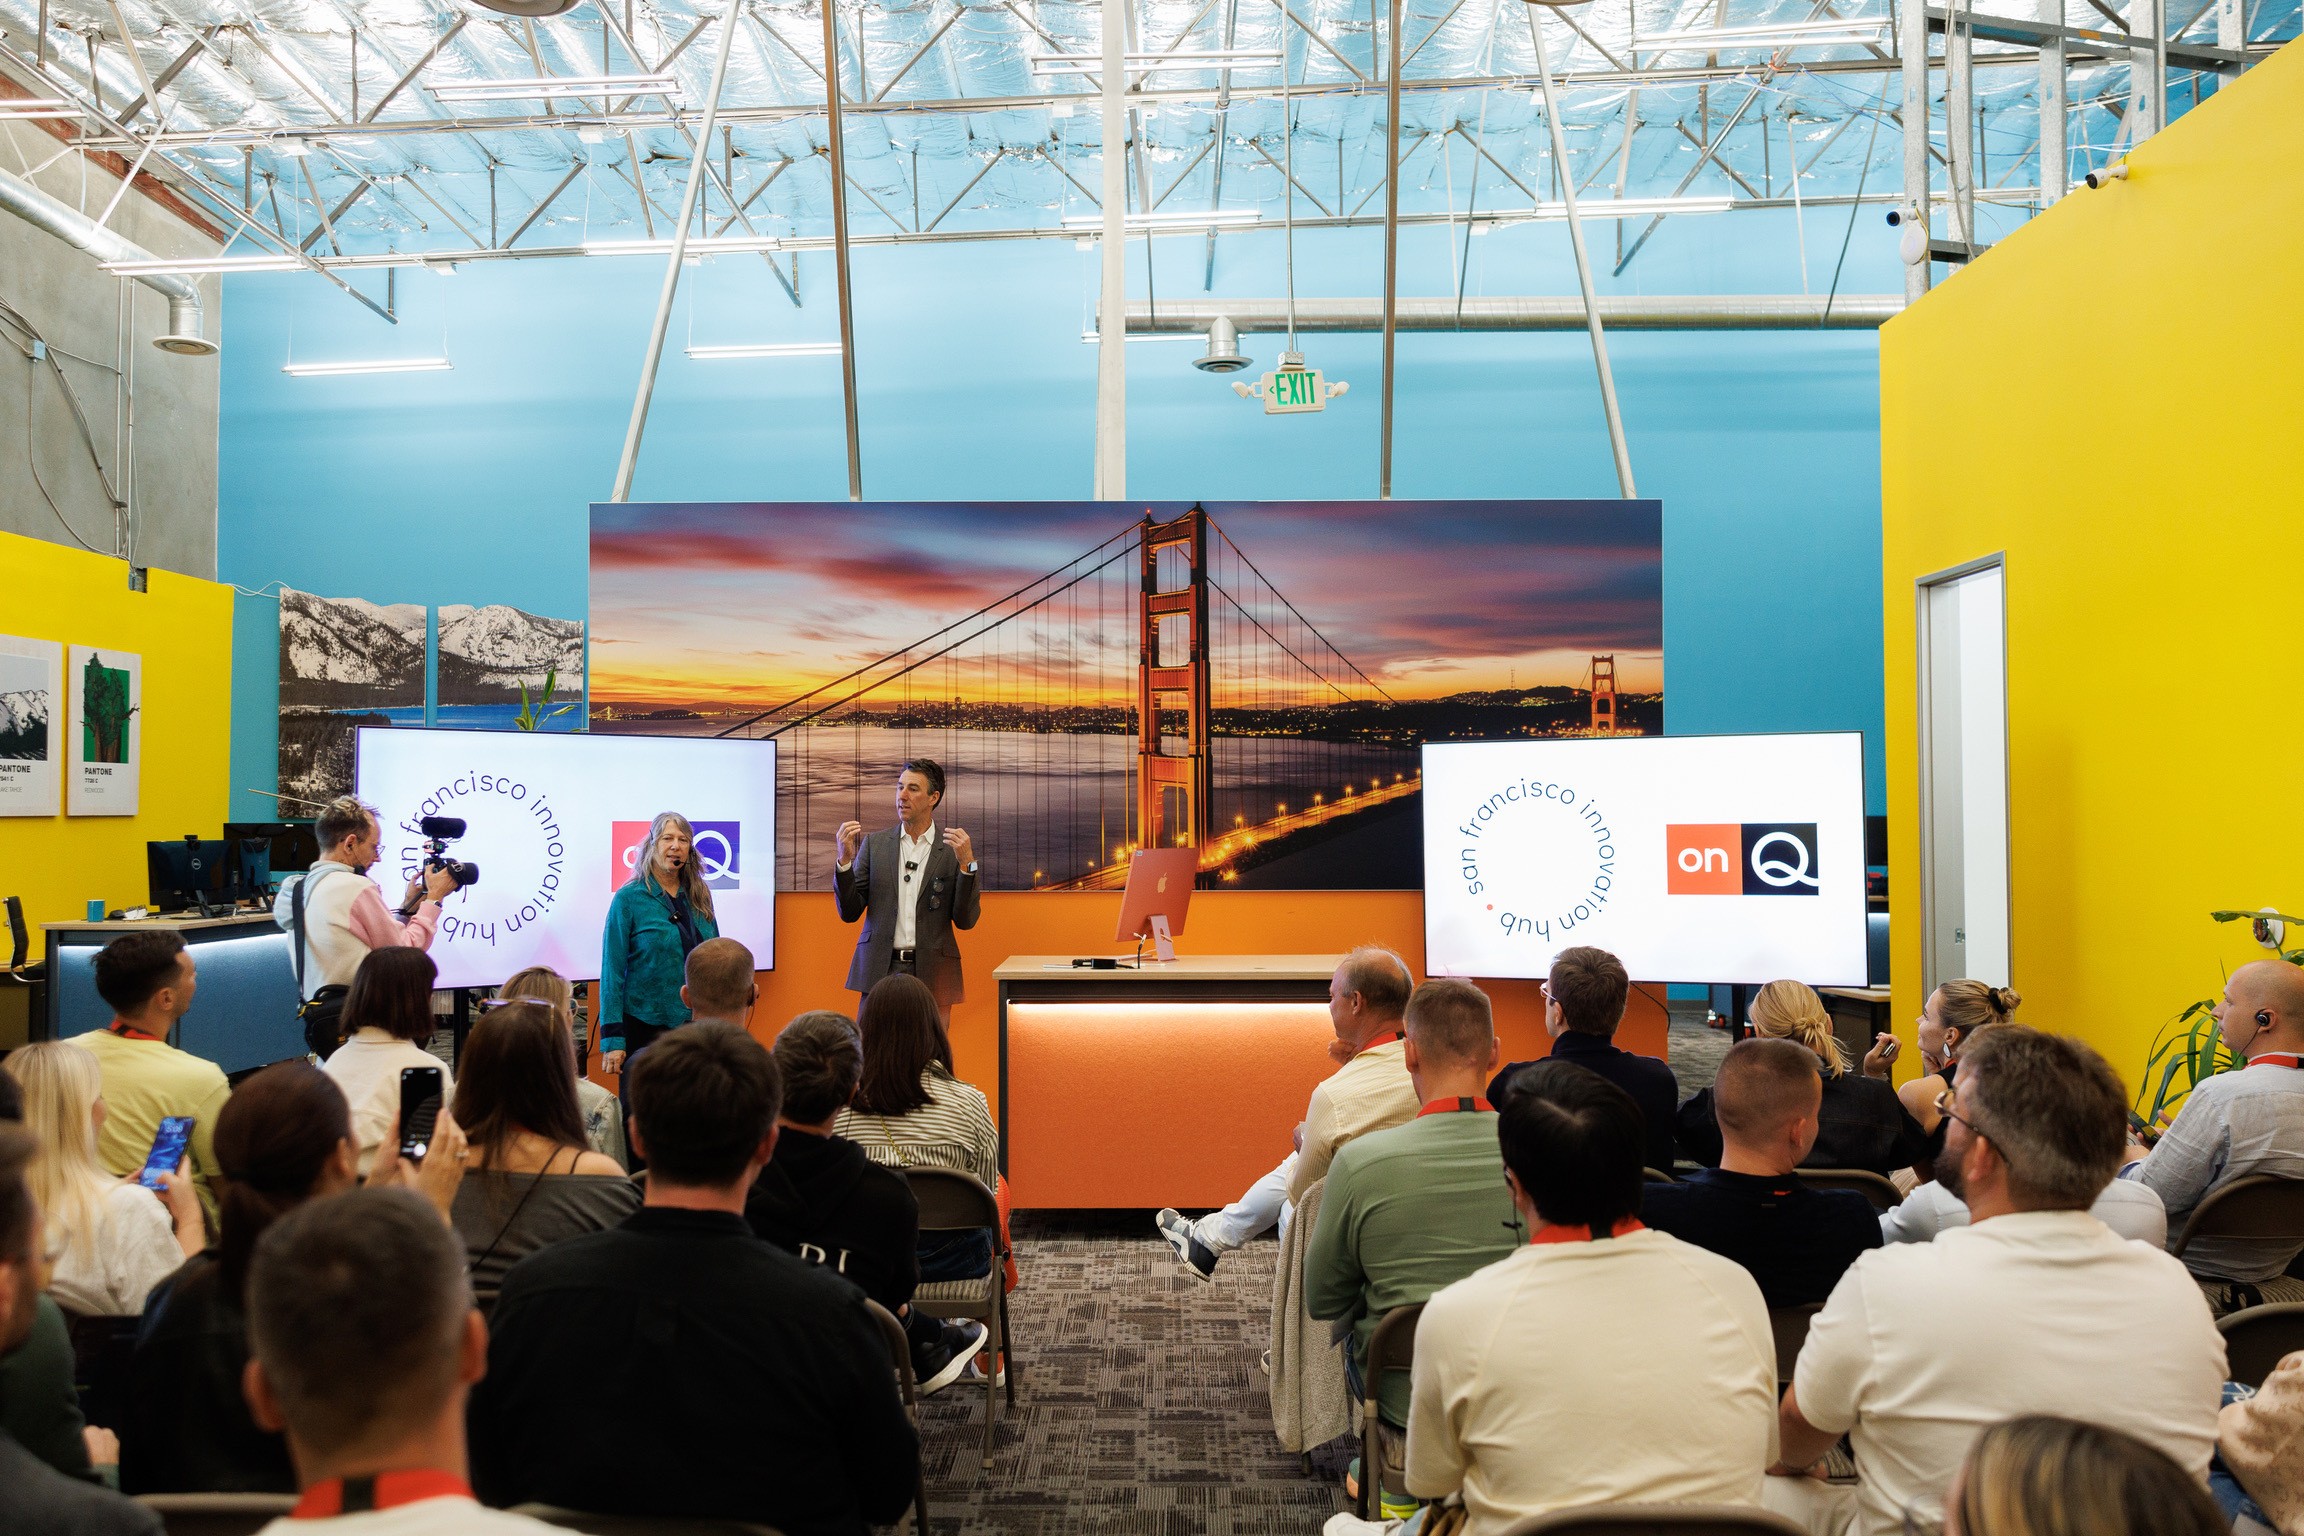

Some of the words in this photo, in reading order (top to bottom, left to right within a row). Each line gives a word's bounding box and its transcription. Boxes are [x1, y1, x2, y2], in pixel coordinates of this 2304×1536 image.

[1274, 372, 1316, 406] EXIT
[0, 764, 31, 773] PANTONE
[84, 767, 113, 776] PANTONE
[400, 770, 527, 835] francisco
[1459, 777, 1575, 839] francisco
[401, 846, 420, 882] an
[505, 794, 564, 932] innovation
[692, 829, 741, 881] Q
[1461, 848, 1484, 895] san
[1558, 798, 1615, 930] innovation
[1677, 847, 1729, 873] on
[1751, 831, 1820, 887] Q
[442, 916, 496, 947] hub
[1500, 912, 1550, 943] hub
